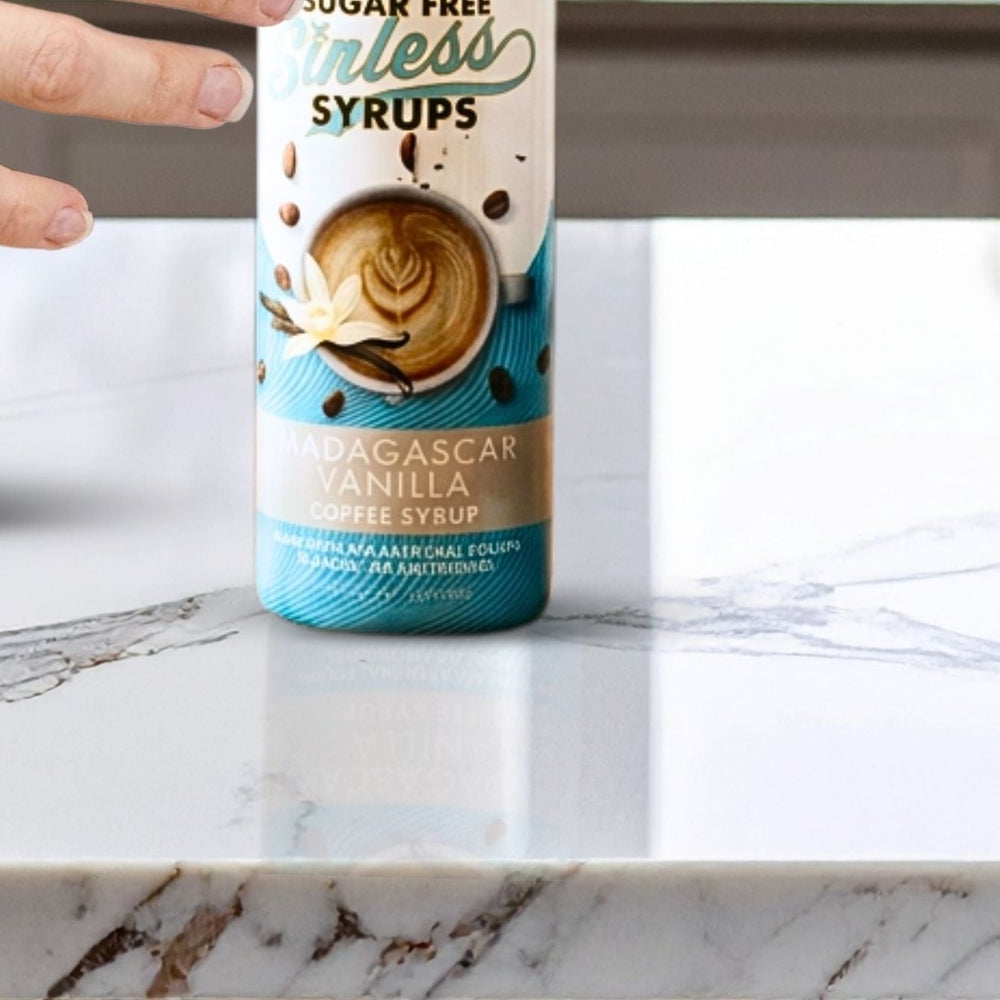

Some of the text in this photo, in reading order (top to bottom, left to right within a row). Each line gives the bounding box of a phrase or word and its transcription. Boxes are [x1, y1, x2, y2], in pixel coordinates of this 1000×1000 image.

[268, 15, 536, 104] Sinless
[312, 95, 478, 131] SYRUPS
[278, 429, 517, 467] MADAGASCAR
[316, 466, 470, 499] VANILLA
